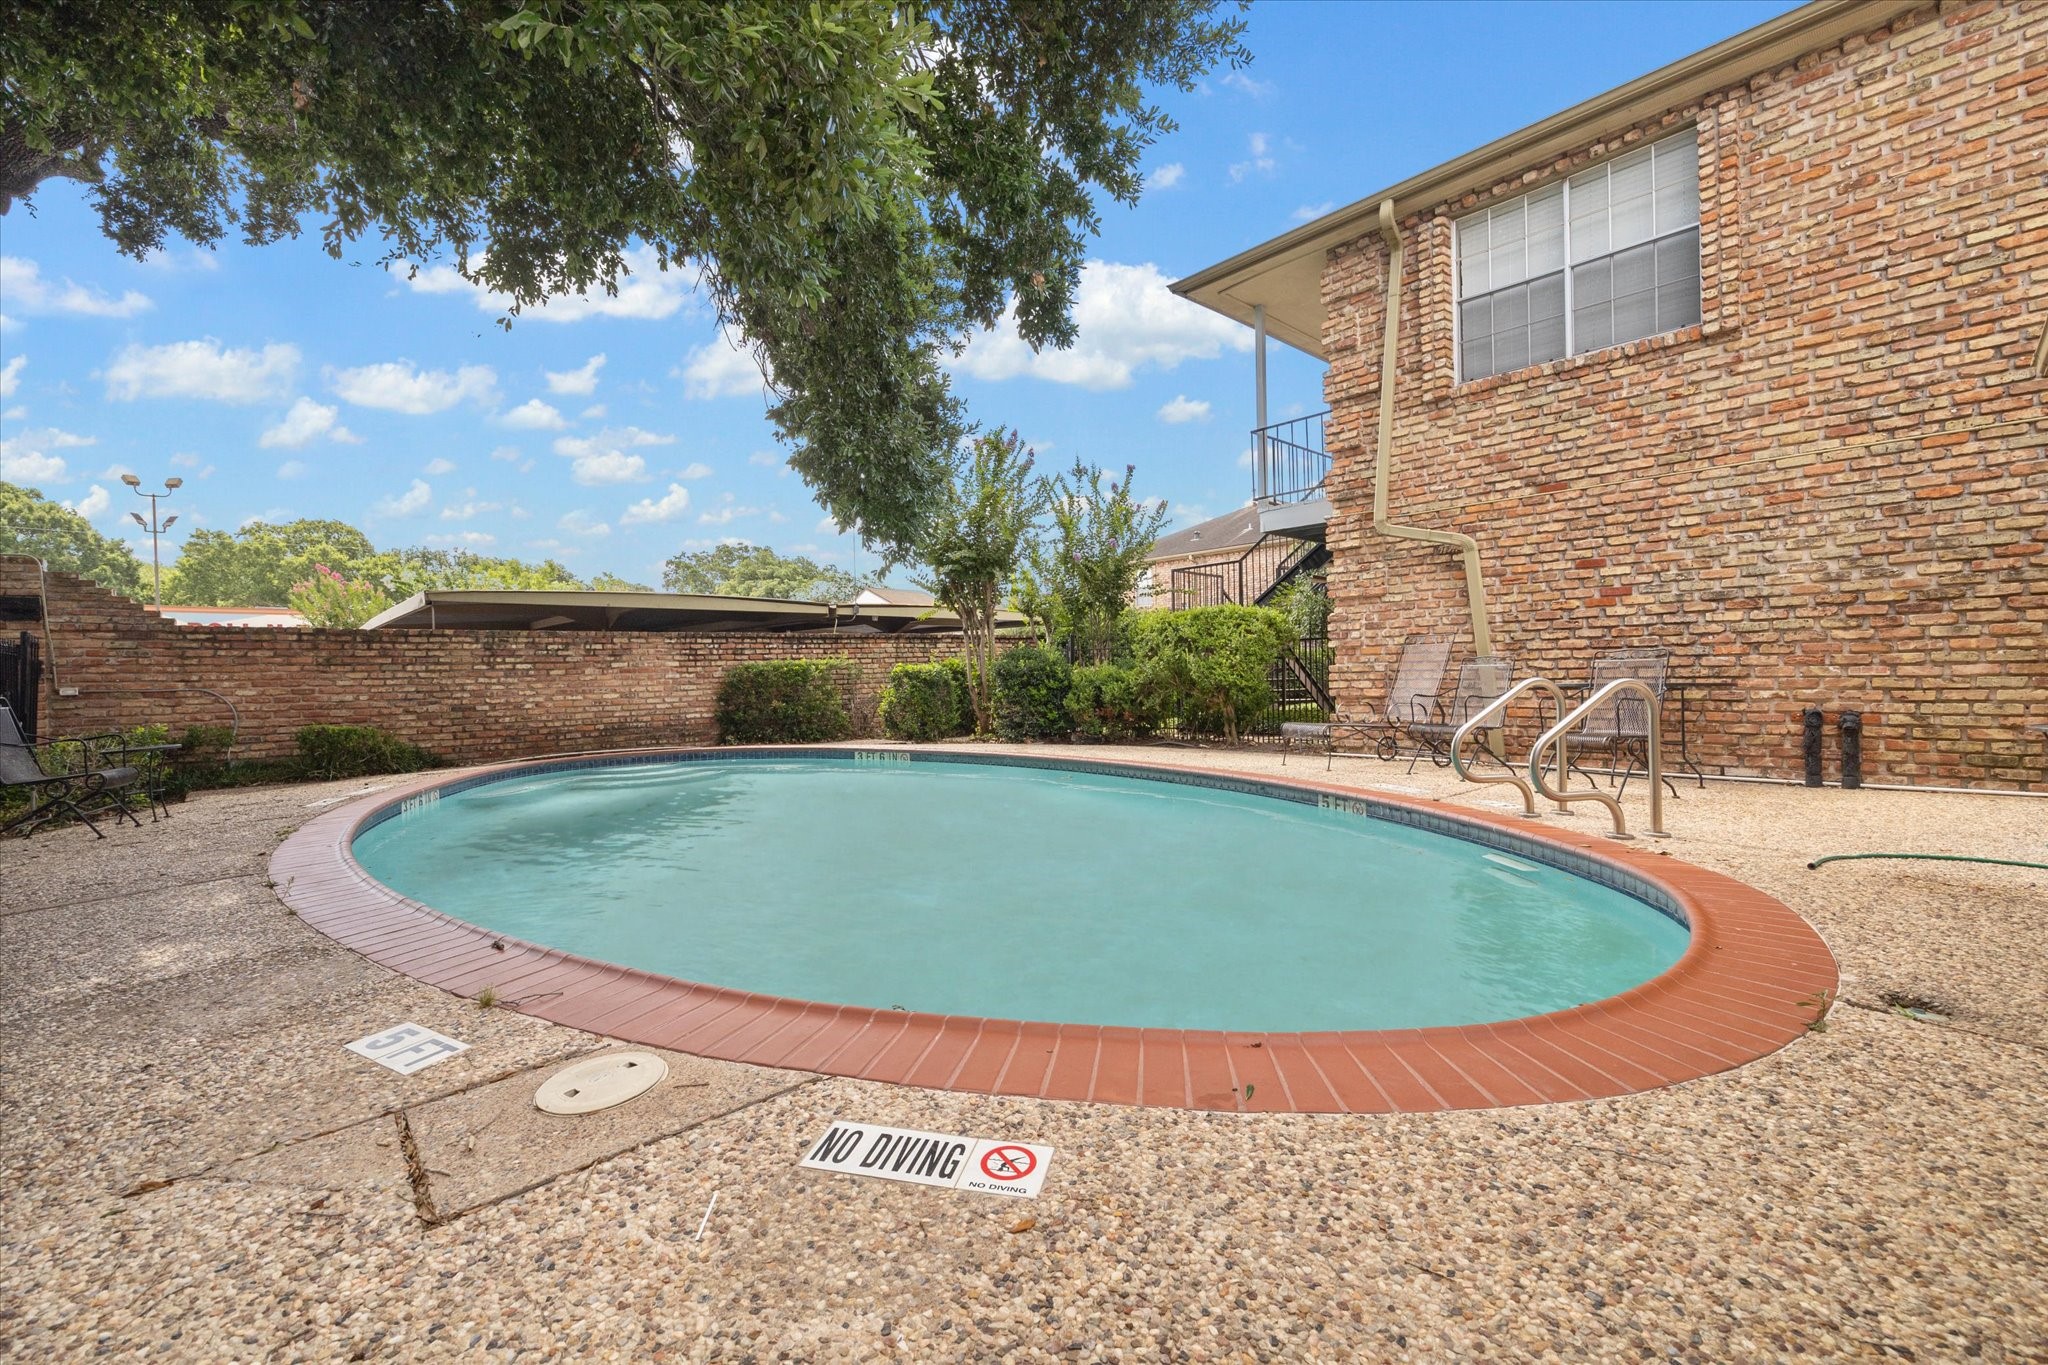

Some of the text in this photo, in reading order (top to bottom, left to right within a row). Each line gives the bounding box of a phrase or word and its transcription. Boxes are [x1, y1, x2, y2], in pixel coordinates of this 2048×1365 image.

[857, 751, 898, 761] 3 FT 6 IN
[1321, 795, 1348, 812] 5 FT
[364, 1027, 460, 1067] 5 FT
[809, 1127, 967, 1180] NO DIVING
[968, 1181, 1028, 1195] NO DIVING
